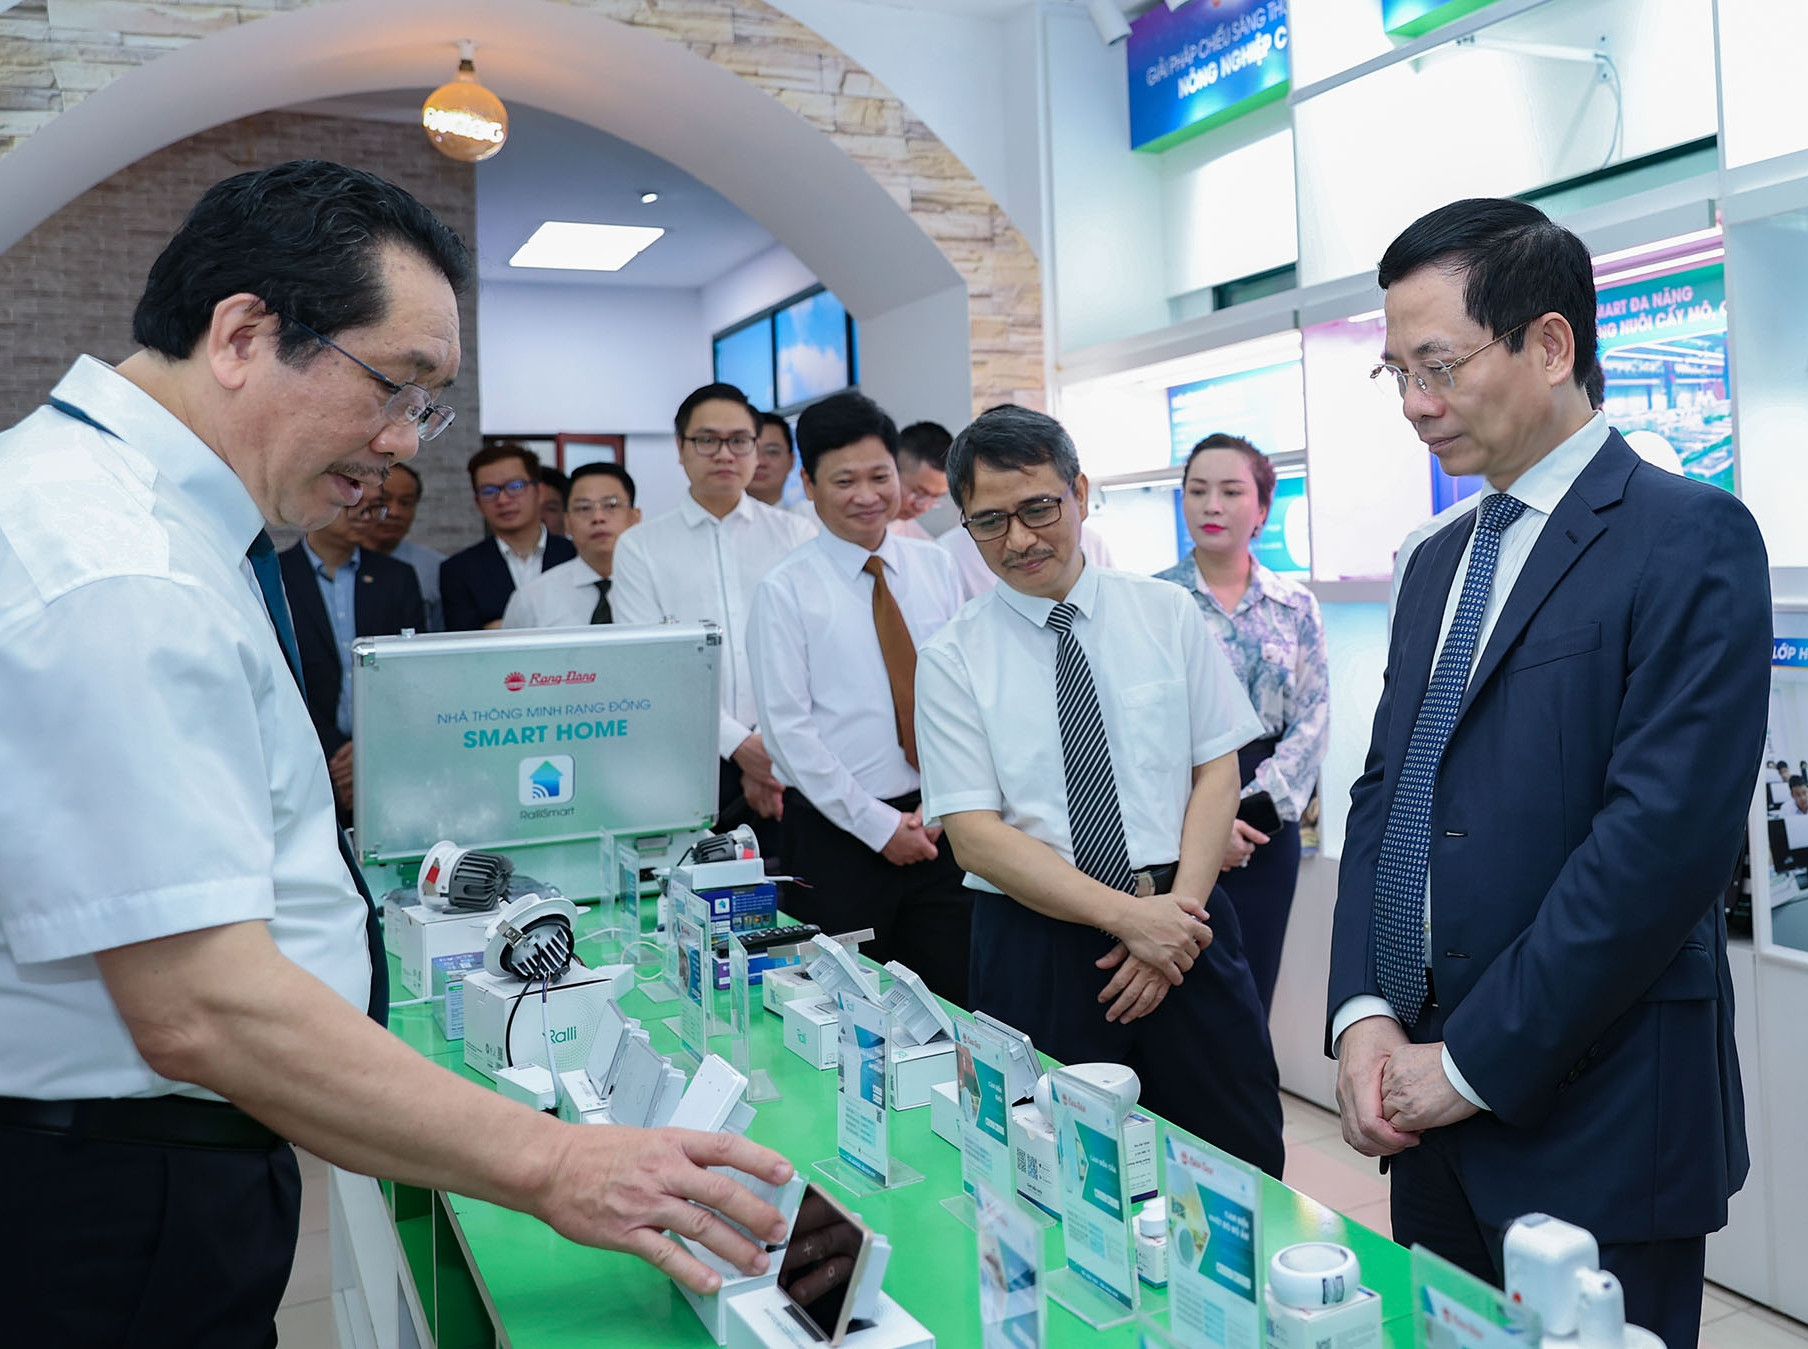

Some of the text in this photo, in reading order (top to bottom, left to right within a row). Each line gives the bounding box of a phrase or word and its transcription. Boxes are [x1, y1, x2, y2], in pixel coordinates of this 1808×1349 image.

[1231, 8, 1266, 41] SÁNG
[1177, 61, 1218, 99] NÔNG
[1220, 32, 1272, 79] NGHIỆP
[1629, 295, 1650, 313] ĐA
[1652, 286, 1694, 307] NĂNG
[1620, 313, 1654, 336] NUÔI
[1655, 304, 1685, 329] CẤY
[1773, 642, 1797, 660] LỚP
[437, 709, 469, 725] NHÀ
[473, 707, 523, 722] THÔNG
[526, 704, 562, 719] MINH
[609, 698, 651, 712] ĐÔNG
[463, 719, 628, 749] SMART HOME
[520, 807, 575, 820] RalliSmart
[542, 1026, 577, 1044] Ralli
